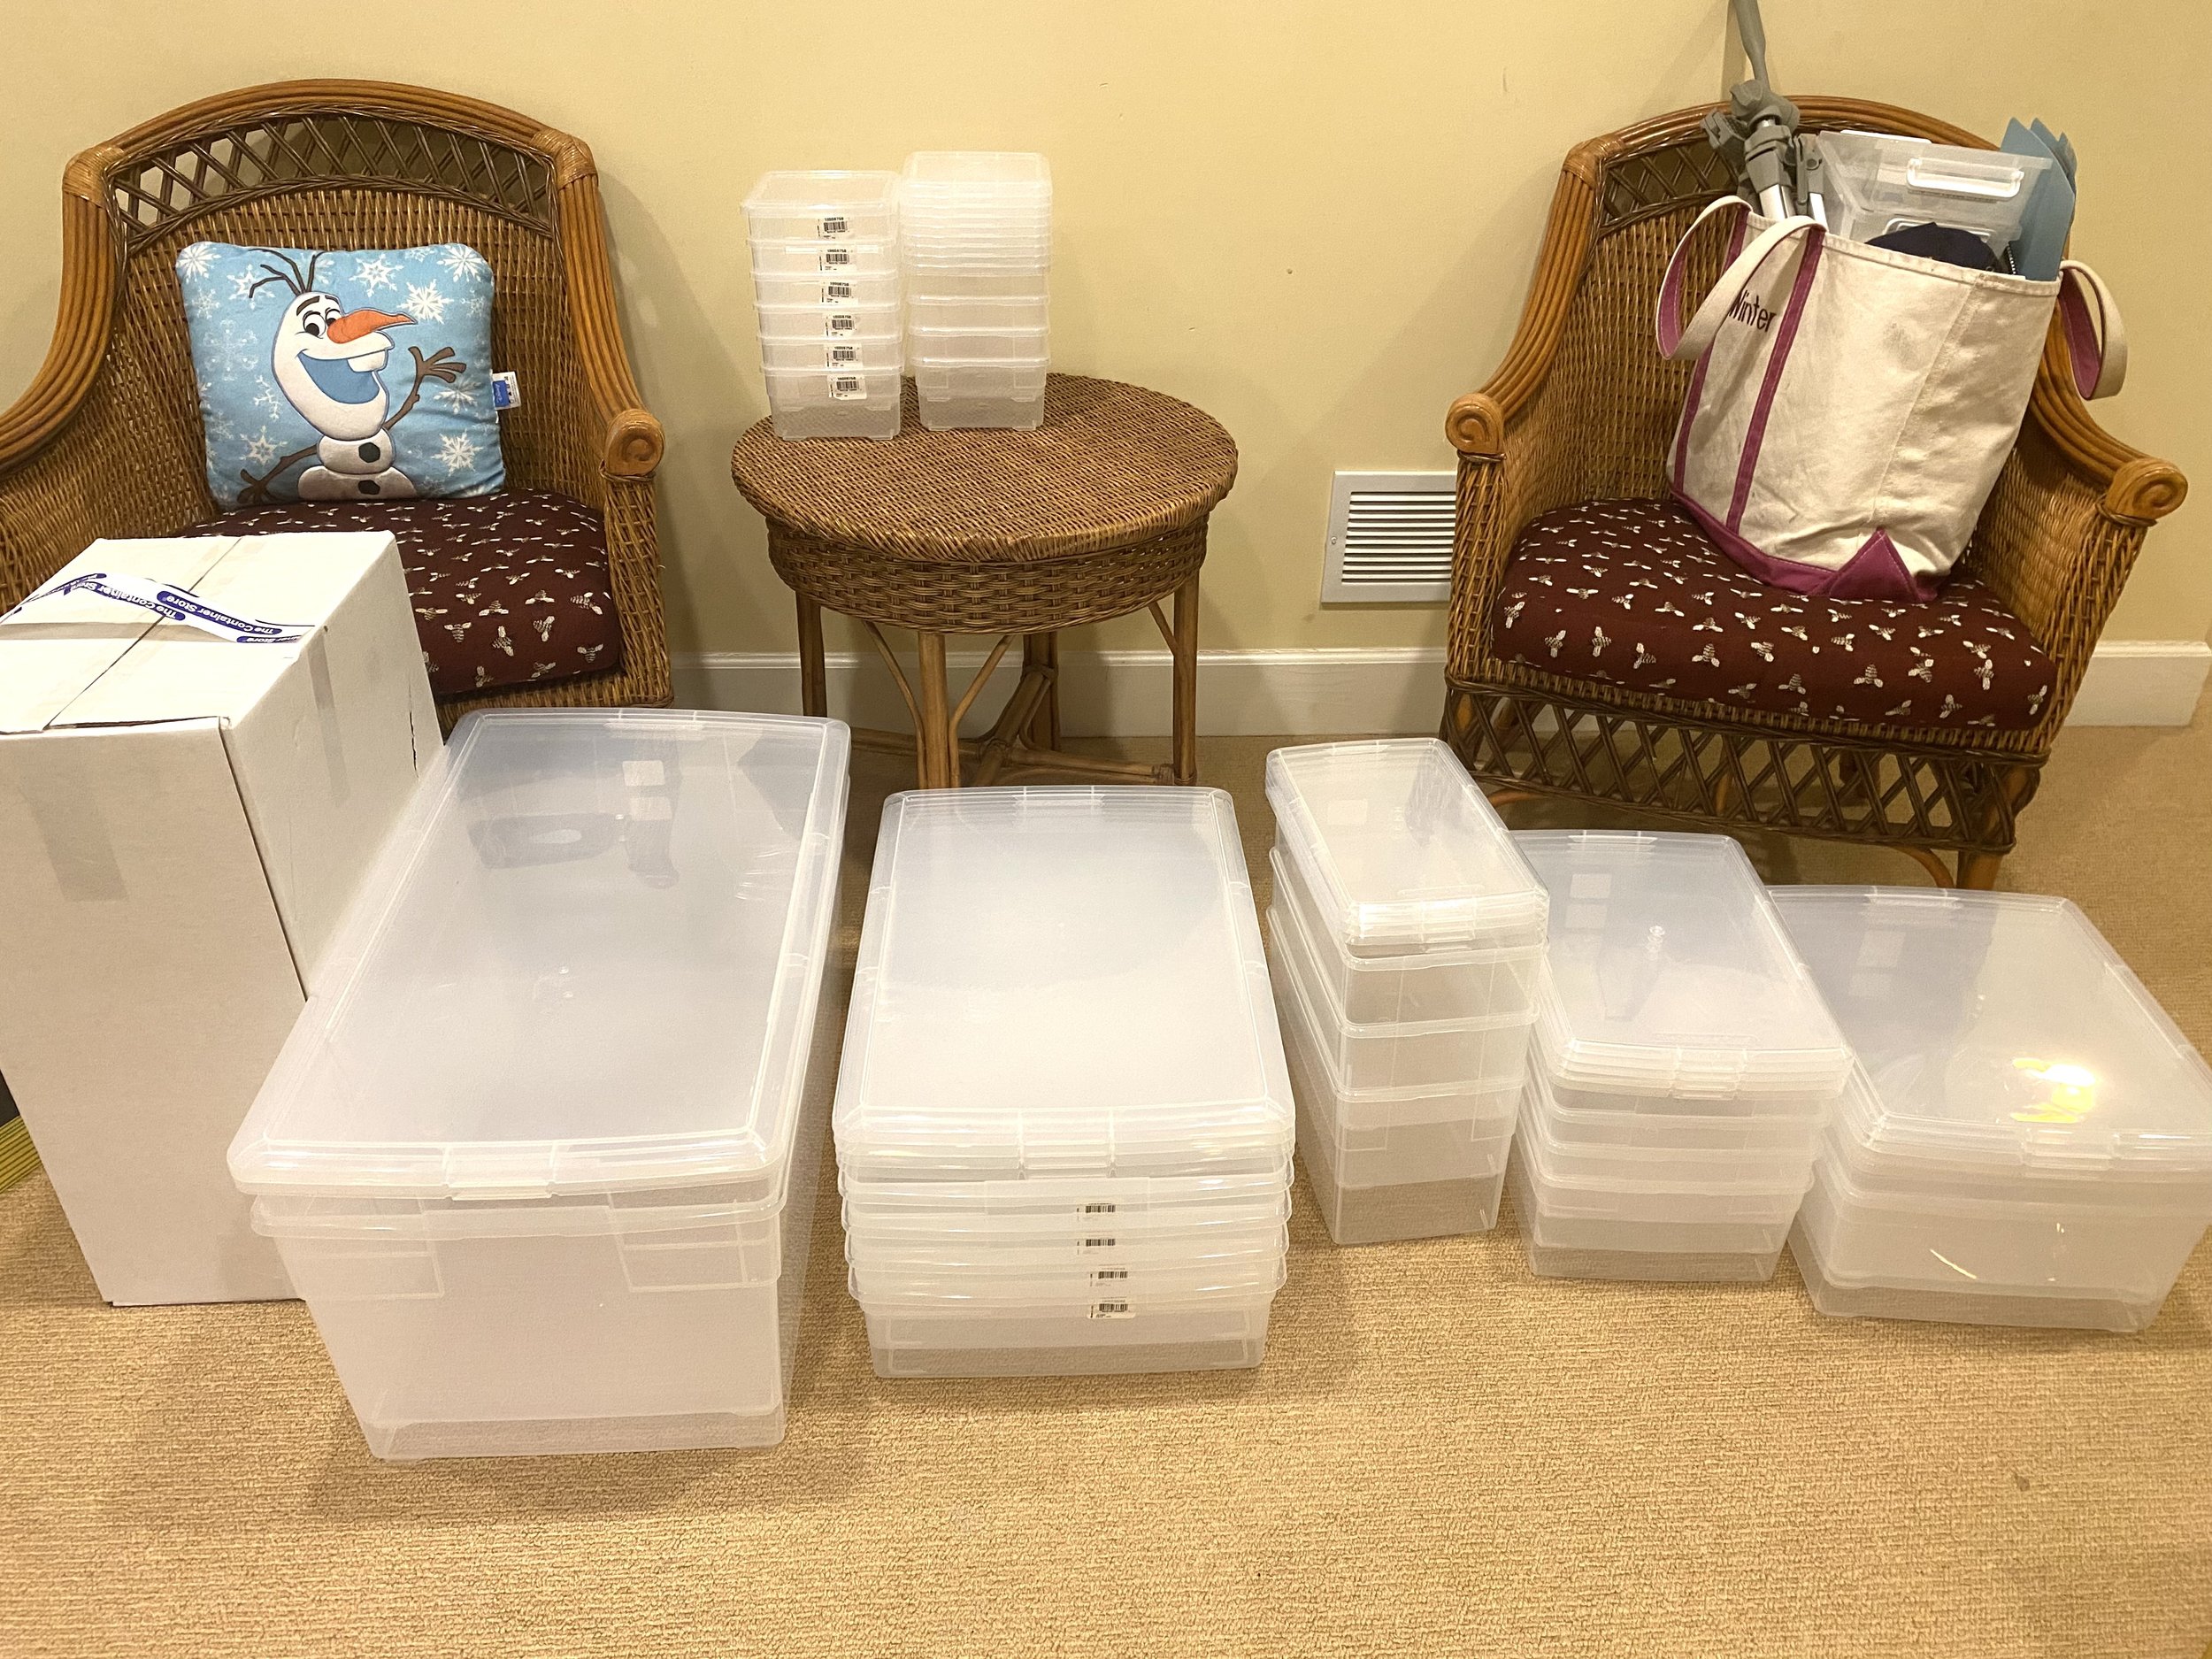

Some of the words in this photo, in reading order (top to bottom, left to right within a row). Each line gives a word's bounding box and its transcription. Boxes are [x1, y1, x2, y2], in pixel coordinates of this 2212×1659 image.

[1729, 289, 1777, 332] Winter
[156, 605, 177, 619] The
[199, 609, 254, 633] Container
[254, 626, 274, 635] The
